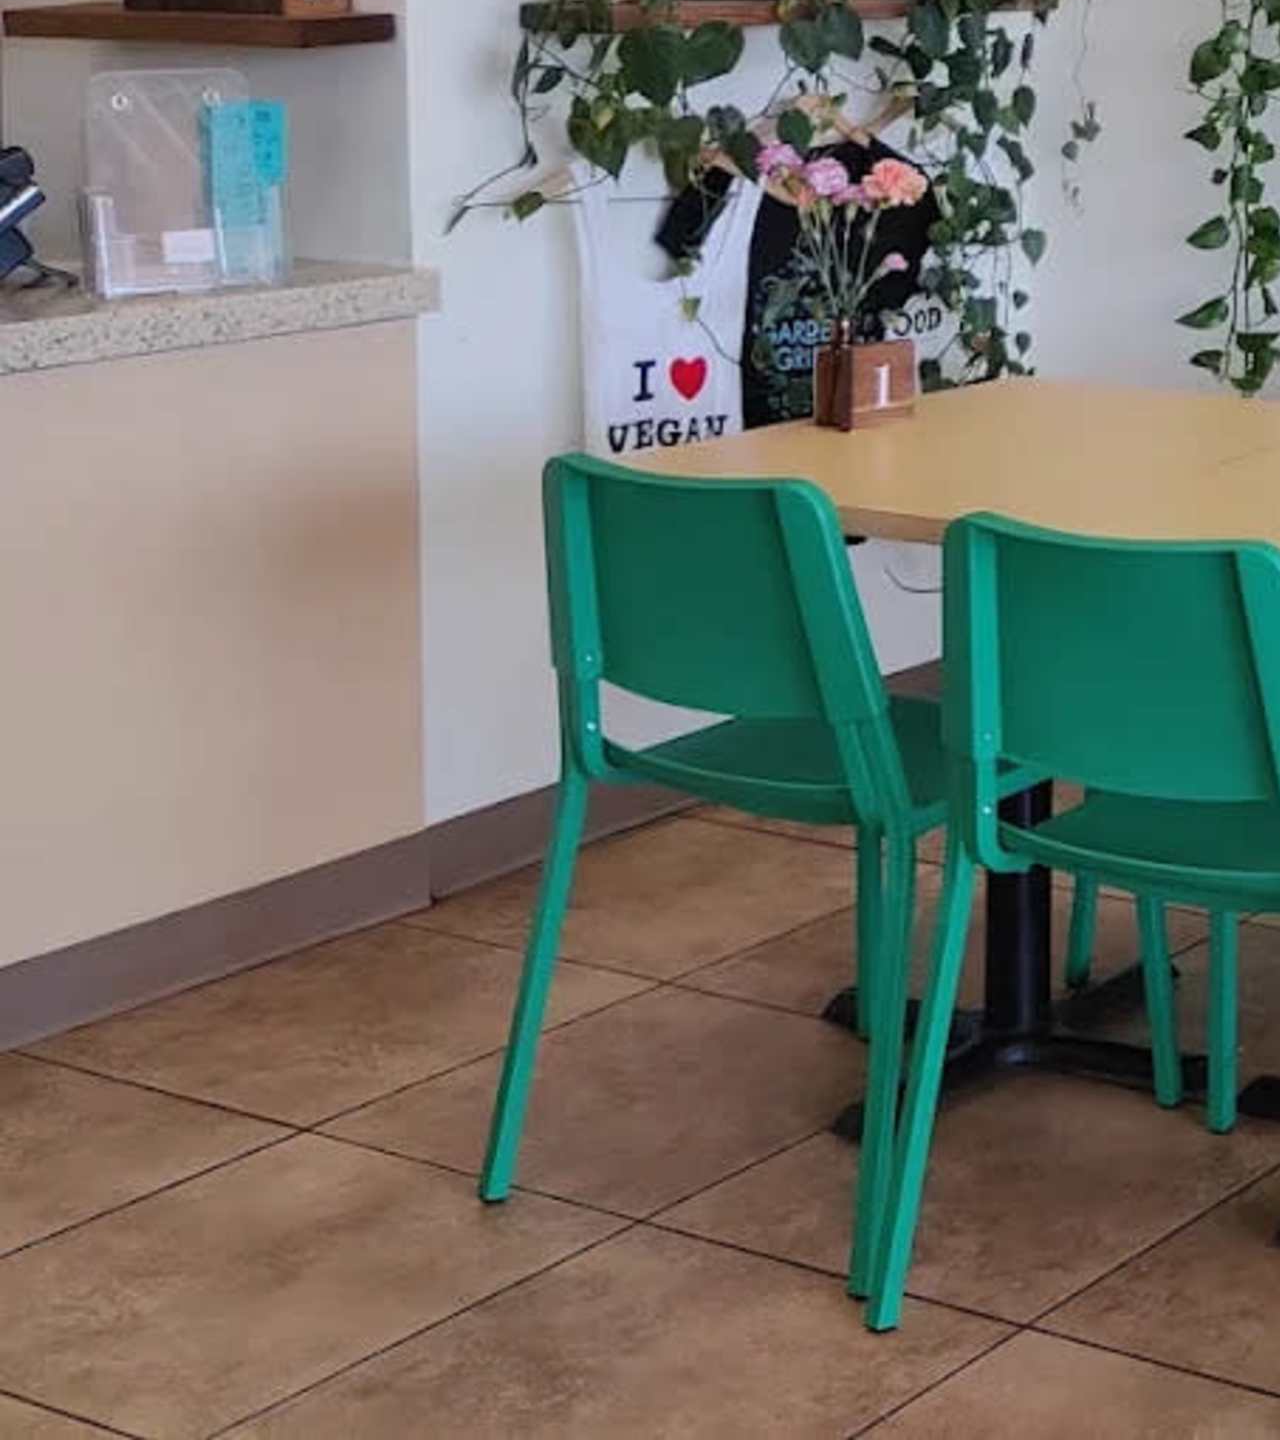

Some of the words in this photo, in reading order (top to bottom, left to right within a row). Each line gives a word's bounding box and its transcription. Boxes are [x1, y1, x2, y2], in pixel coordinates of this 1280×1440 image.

[762, 318, 833, 346] GARDE
[892, 306, 943, 338] OOD
[632, 358, 657, 403] I
[872, 363, 891, 408] 1
[608, 413, 729, 454] VEGAN
